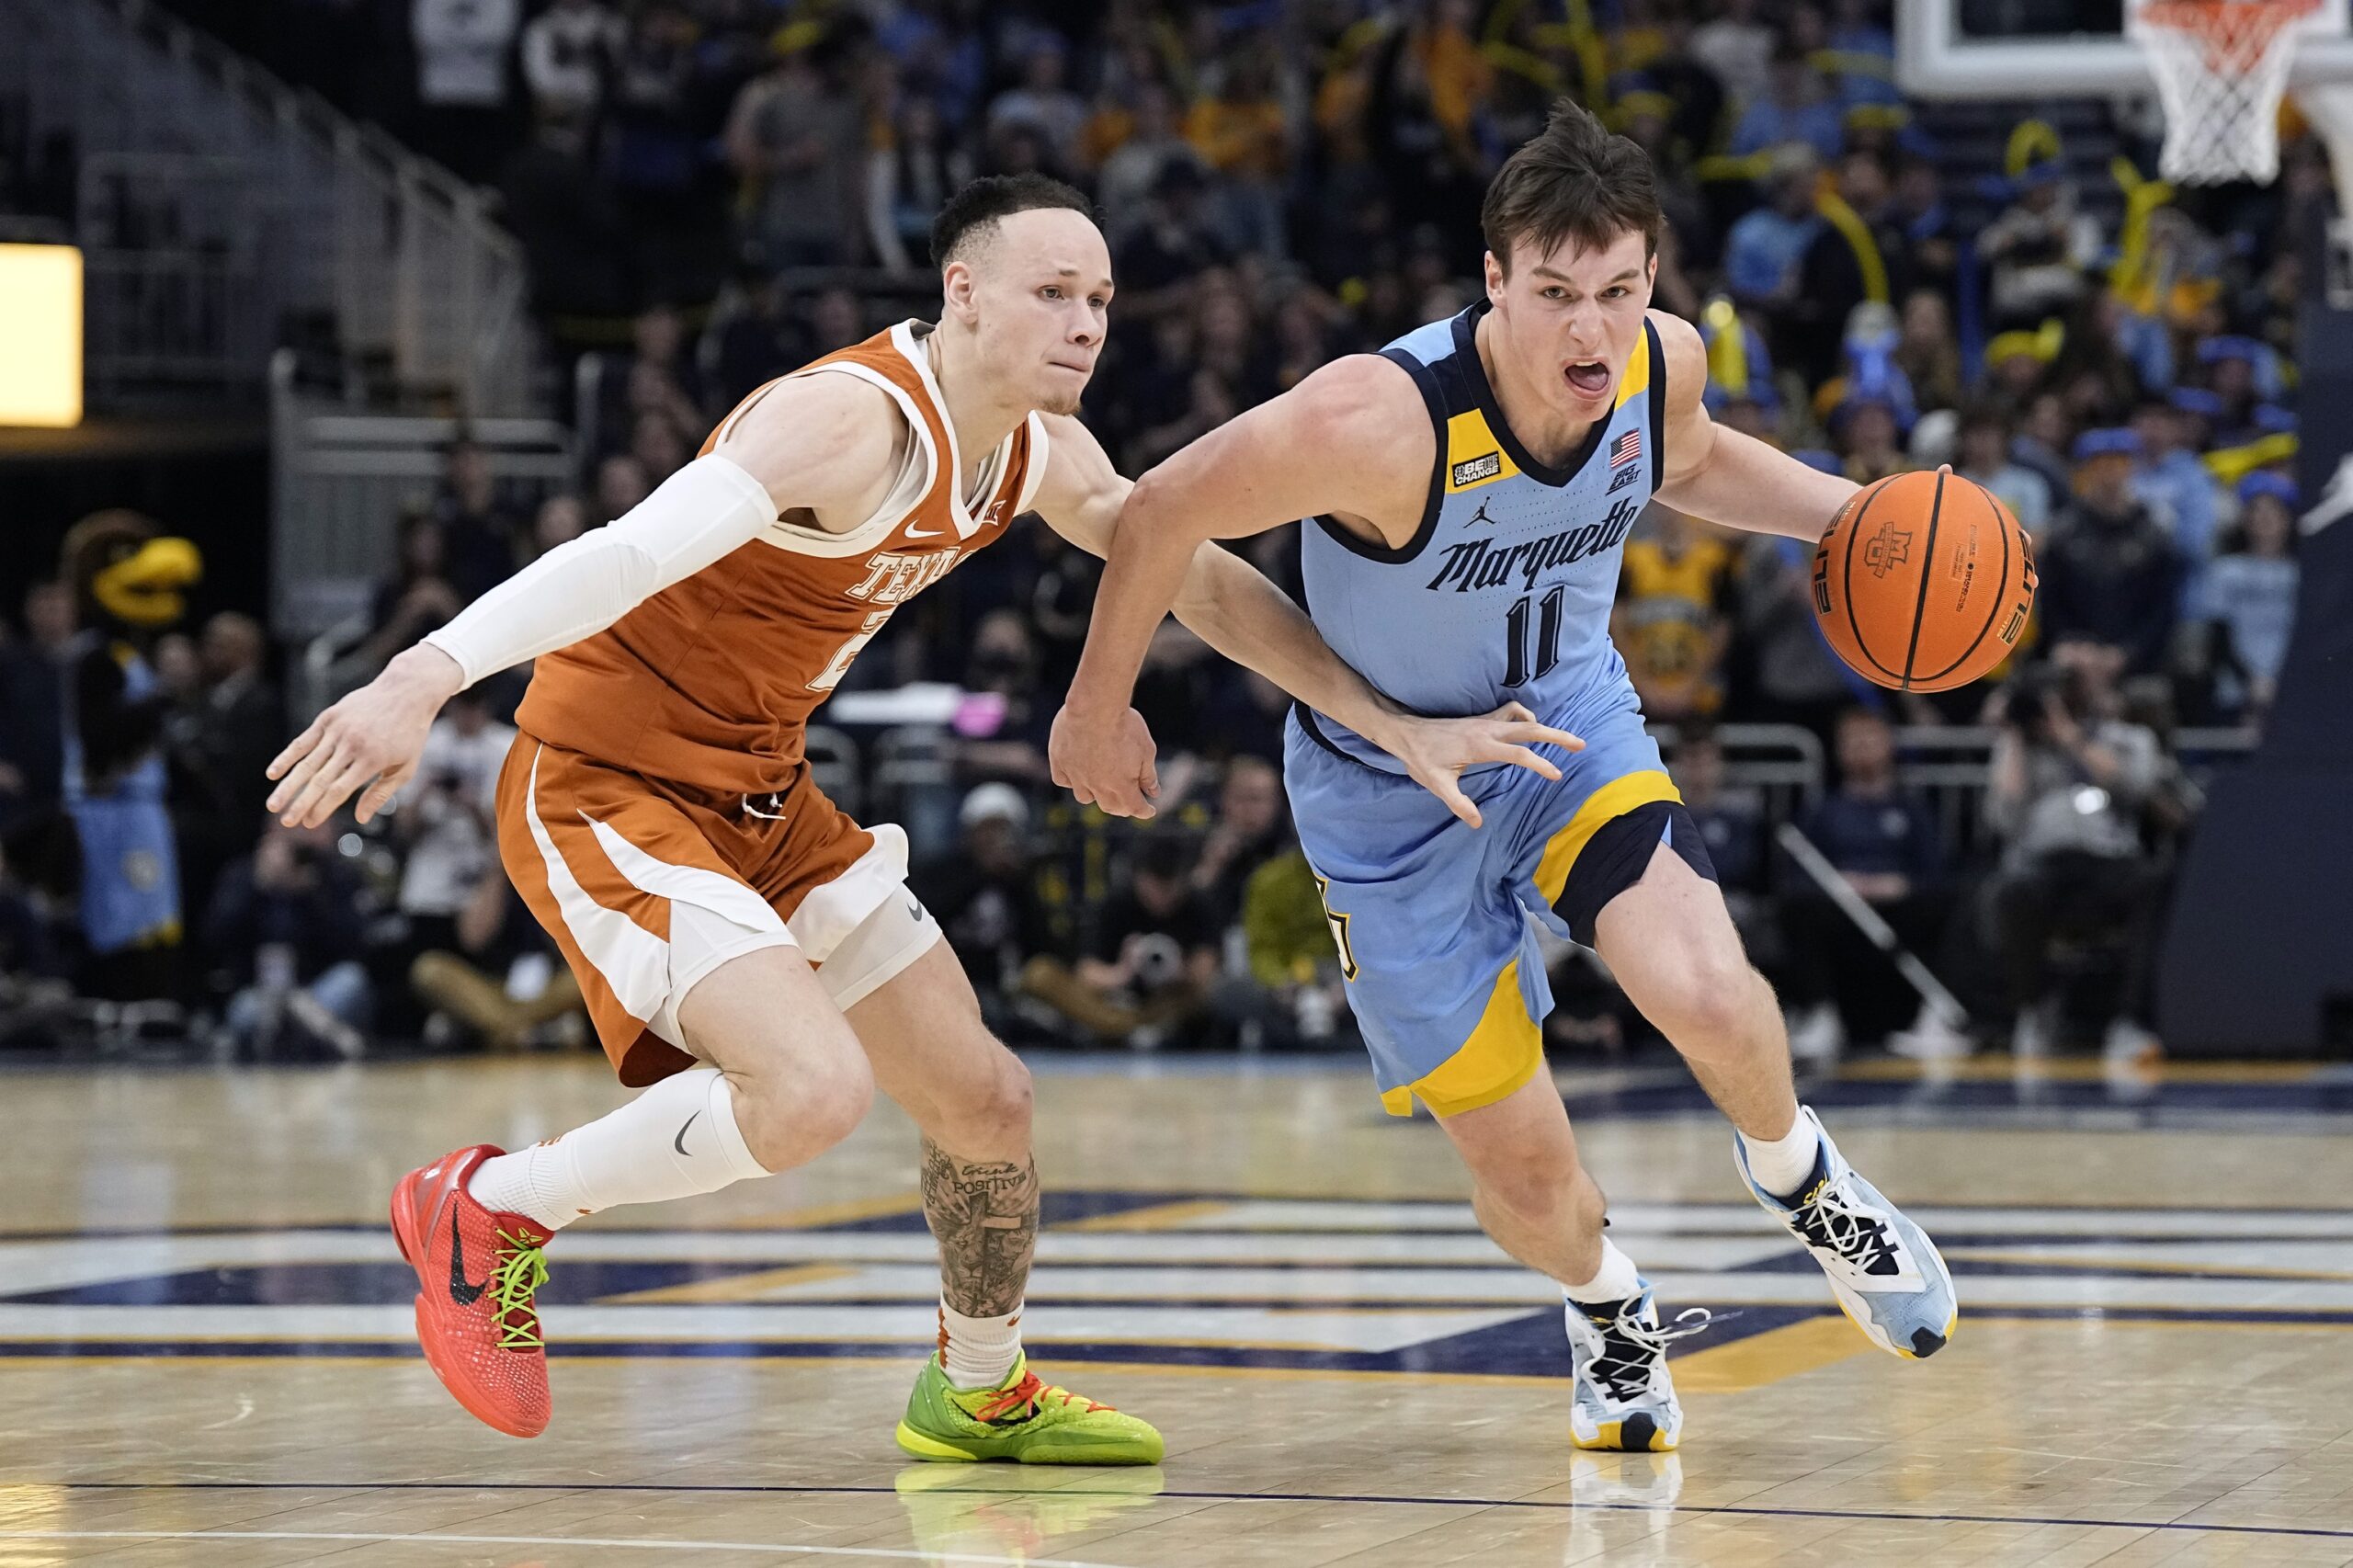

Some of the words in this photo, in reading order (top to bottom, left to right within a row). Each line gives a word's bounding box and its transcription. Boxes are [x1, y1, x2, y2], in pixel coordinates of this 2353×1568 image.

[1456, 466, 1499, 484] CHANGE
[1608, 469, 1642, 492] EAST
[1613, 463, 1637, 482] BIG
[1426, 495, 1639, 593] Marquette
[845, 546, 981, 606] TEXA
[1499, 585, 1565, 688] 11
[952, 1172, 1027, 1194] POSITIVE
